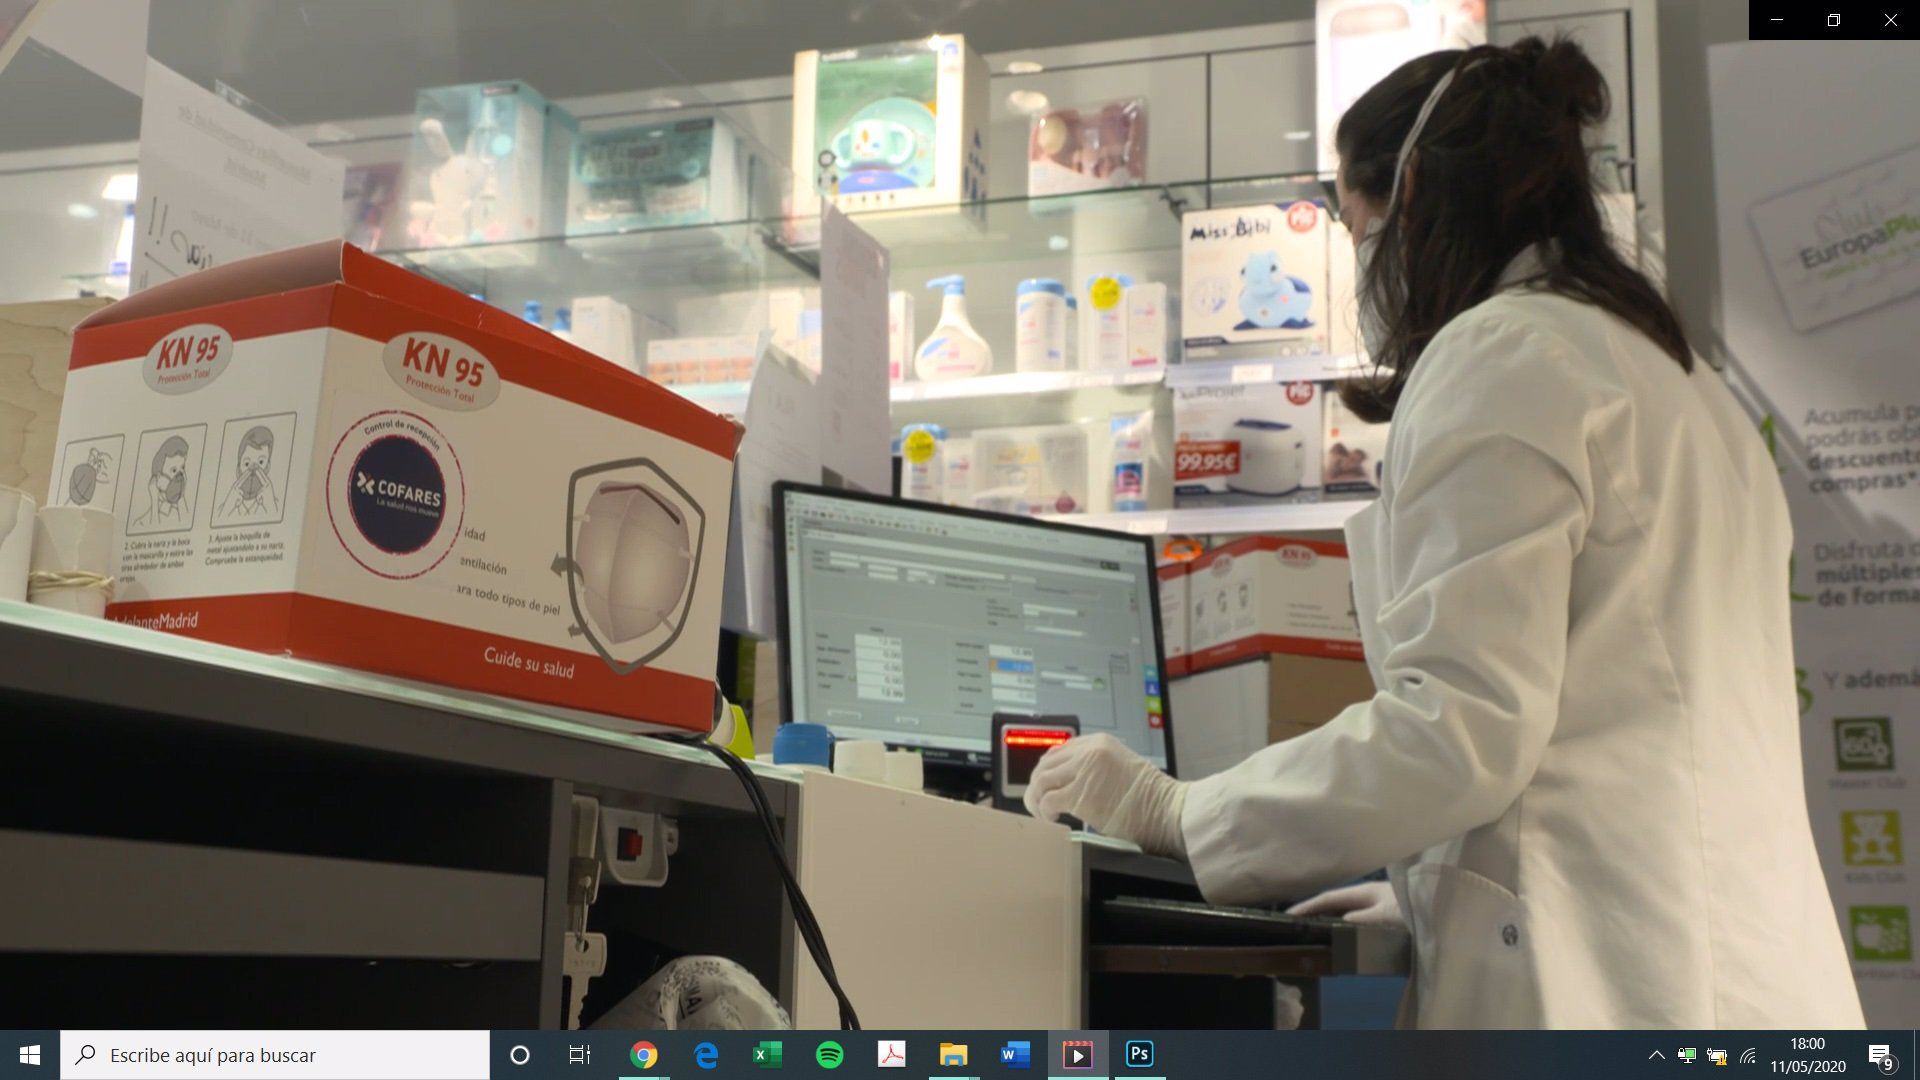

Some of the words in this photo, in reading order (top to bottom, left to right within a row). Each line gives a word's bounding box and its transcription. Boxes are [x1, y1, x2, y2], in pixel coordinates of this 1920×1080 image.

[1800, 213, 1920, 270] EuropaPlu
[156, 335, 195, 370] KN
[195, 333, 222, 364] 95
[402, 336, 451, 379] KN
[455, 357, 485, 388] 95
[193, 367, 212, 378] Total
[406, 374, 451, 397] Protección
[453, 388, 475, 403] Total
[1805, 402, 1899, 425] Acumula
[364, 419, 393, 435] Control
[394, 420, 405, 428] de
[406, 423, 440, 452] recepción
[376, 497, 386, 506] La
[386, 499, 405, 511] salud
[405, 503, 417, 512] nos
[377, 480, 441, 508] COFARES
[464, 527, 486, 542] idad
[1814, 541, 1904, 562] Disfruta
[460, 556, 508, 576] entilación
[456, 584, 472, 597] ara
[475, 588, 499, 602] todo
[502, 593, 526, 611] tipos
[529, 599, 541, 612] de
[543, 604, 561, 616] piel
[1818, 587, 1847, 607] de
[484, 646, 522, 668] Cuide
[525, 658, 540, 672] su
[543, 662, 575, 679] salud
[1823, 671, 1840, 689] Y
[1845, 666, 1920, 689] ademá
